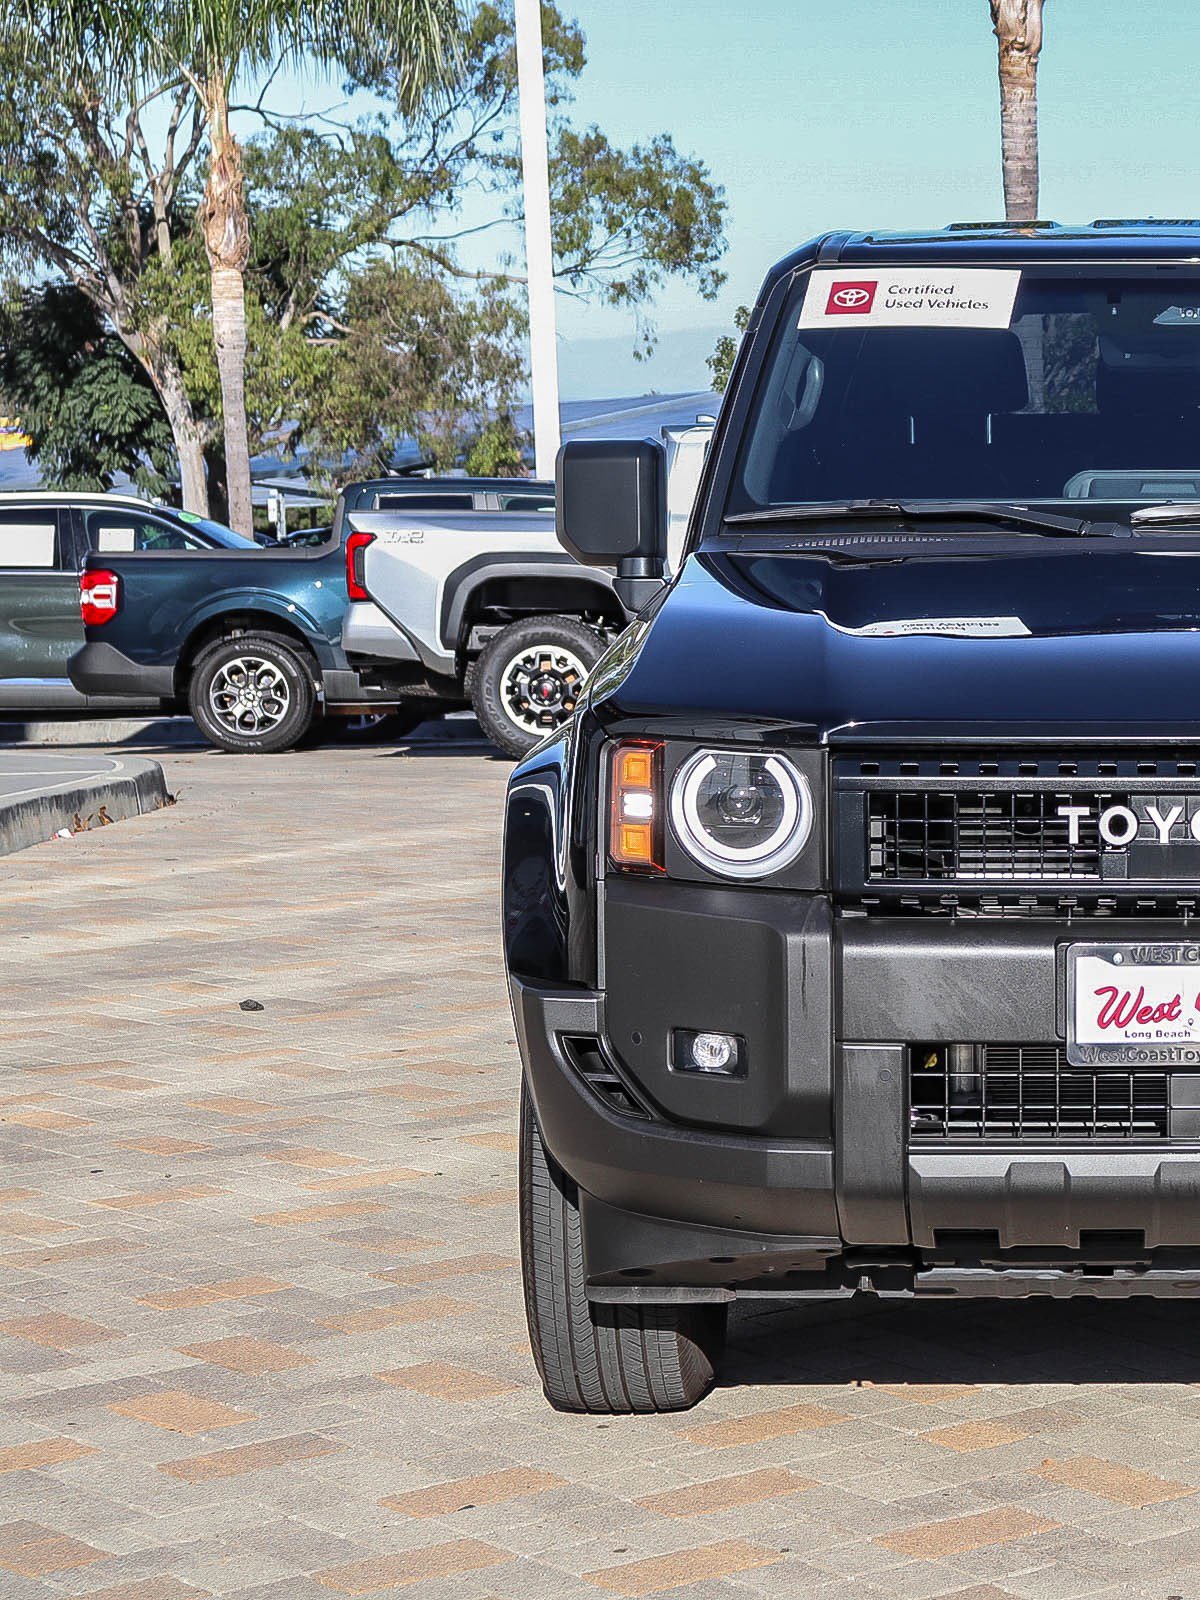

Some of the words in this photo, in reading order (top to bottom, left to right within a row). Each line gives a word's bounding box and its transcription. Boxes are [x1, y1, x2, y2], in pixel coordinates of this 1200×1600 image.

[888, 284, 955, 295] Certified
[885, 298, 923, 309] Used
[928, 298, 990, 310] Vehicles
[1131, 947, 1183, 963] WEST
[1094, 985, 1182, 1029] West
[1124, 1029, 1153, 1040] Long
[1155, 1029, 1191, 1039] Beach
